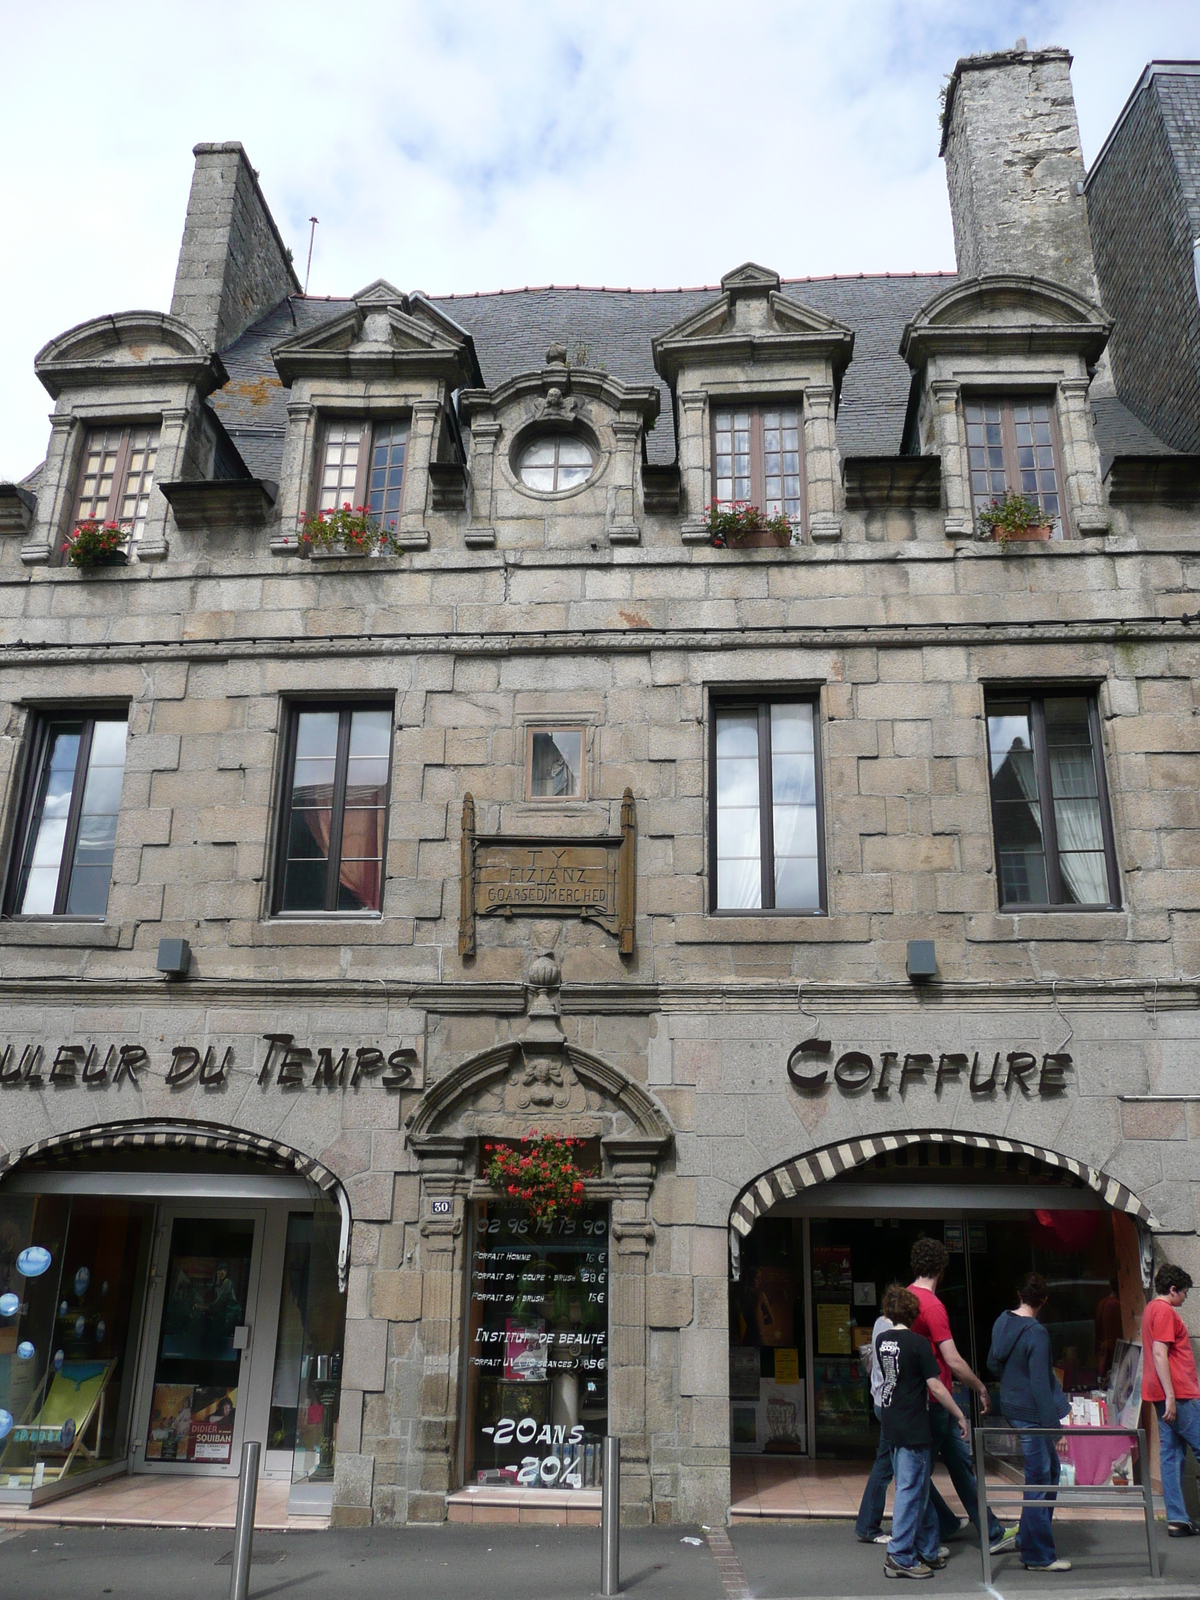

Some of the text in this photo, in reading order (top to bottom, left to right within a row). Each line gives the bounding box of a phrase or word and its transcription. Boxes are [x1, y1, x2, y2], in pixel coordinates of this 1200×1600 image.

[508, 868, 587, 883] FIZIANZ
[165, 1045, 234, 1084] DU
[257, 1033, 417, 1086] TEMPS
[786, 1038, 1073, 1094] COIFFURE
[434, 1202, 449, 1212] 30
[476, 1218, 501, 1233] 02
[583, 1219, 606, 1235] 90
[472, 1251, 504, 1260] FORFAIT
[472, 1271, 504, 1280] FORFAIT
[522, 1273, 546, 1281] COUPE
[553, 1274, 576, 1282] BRUSH
[471, 1292, 504, 1301] FORFAIT
[522, 1295, 545, 1303] BRUSH
[474, 1328, 605, 1345] INSTITUT DE BEAUTÉ
[469, 1357, 502, 1367] FORFAIT
[192, 1425, 217, 1433] DIDIER
[505, 1456, 580, 1483] -20%
